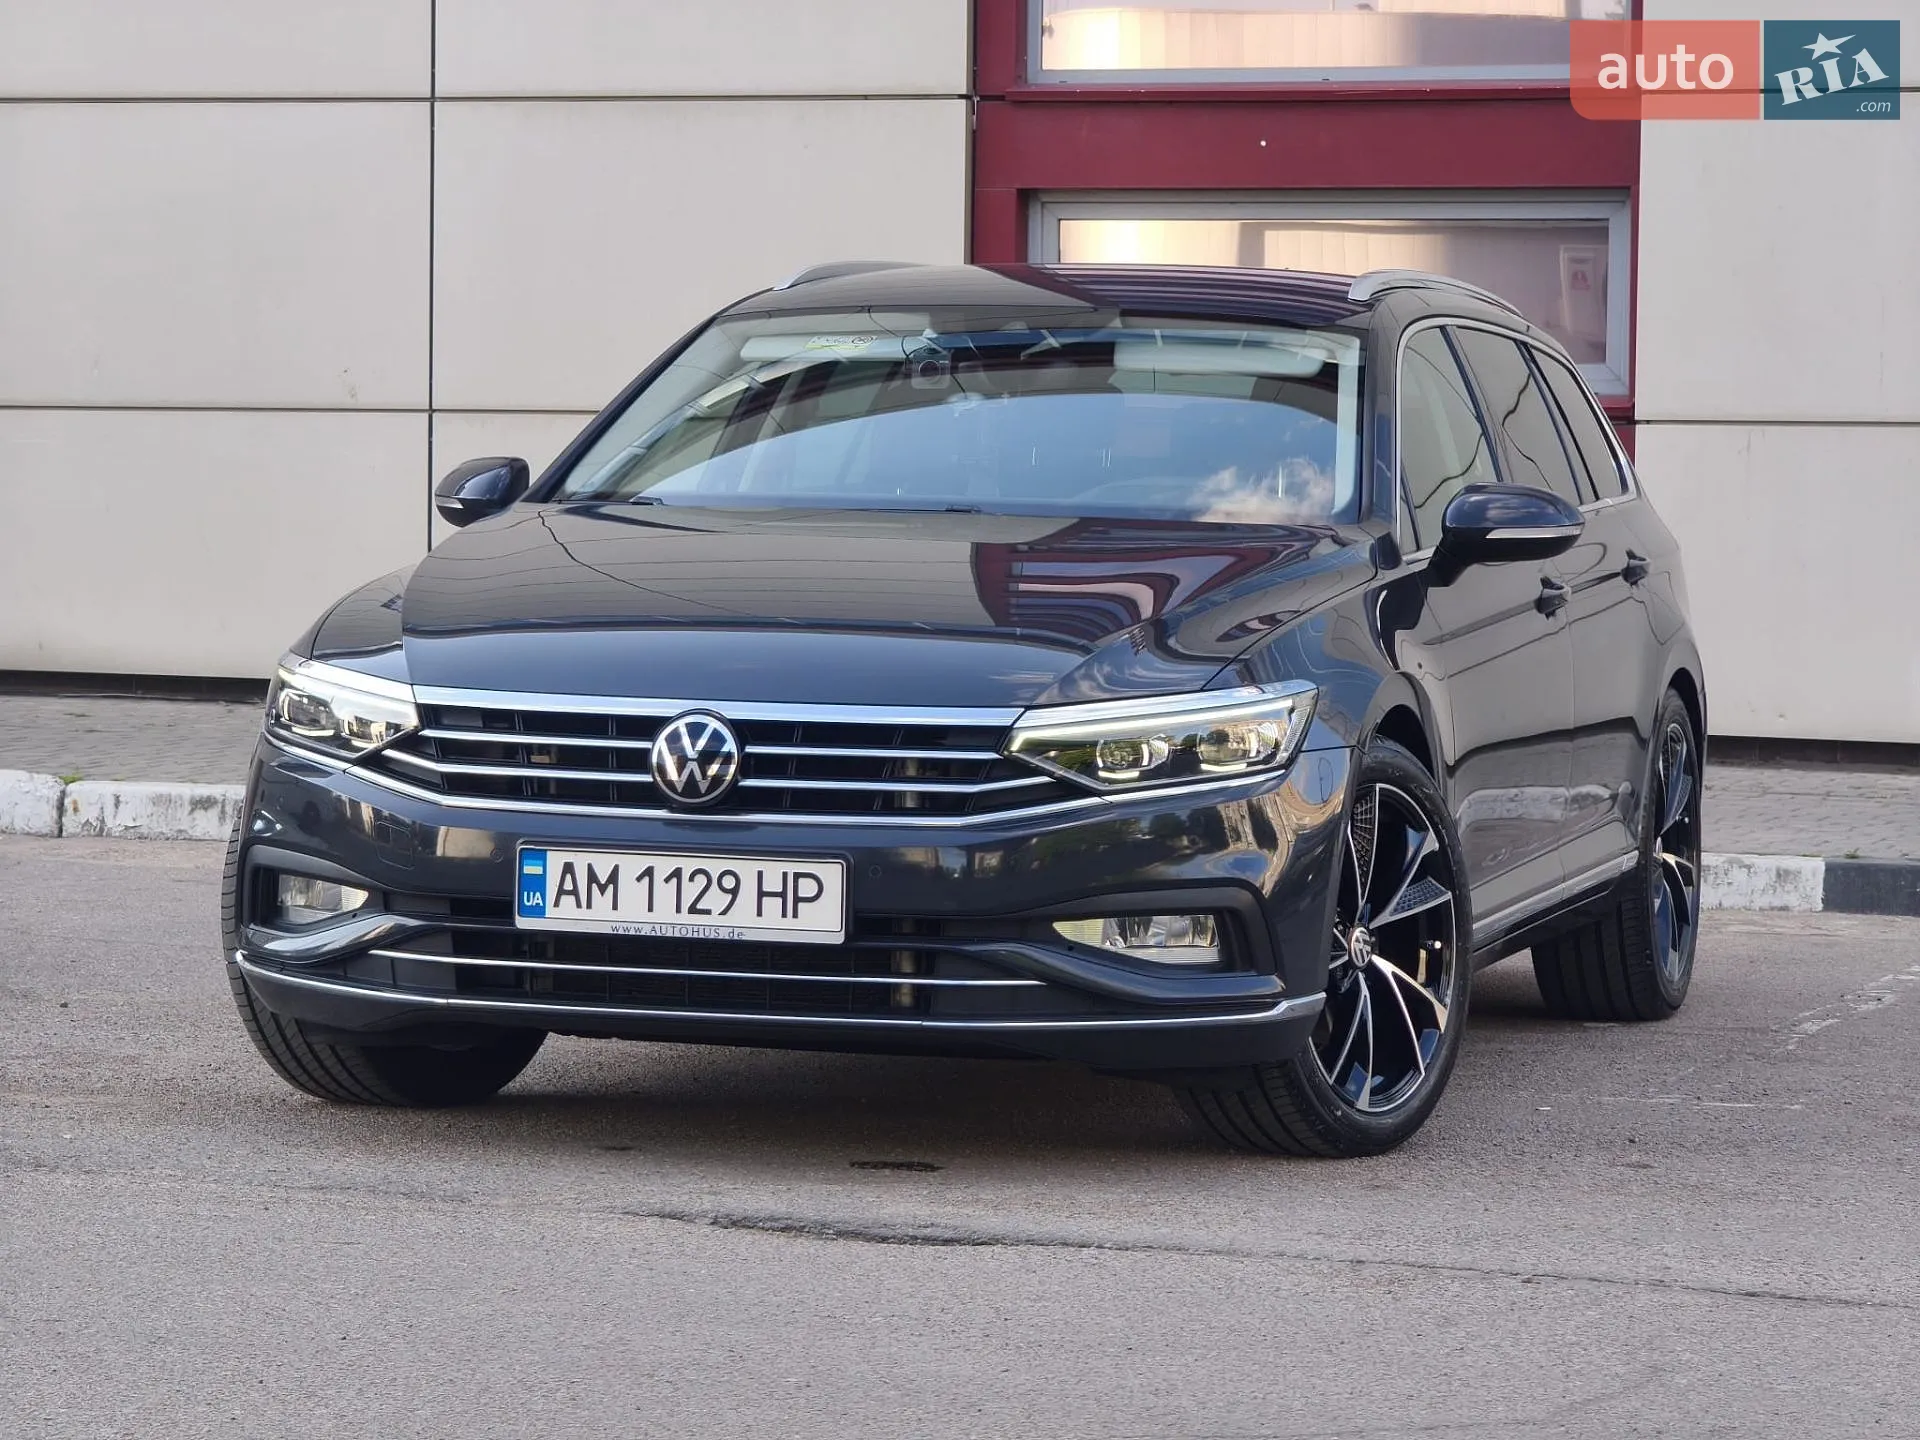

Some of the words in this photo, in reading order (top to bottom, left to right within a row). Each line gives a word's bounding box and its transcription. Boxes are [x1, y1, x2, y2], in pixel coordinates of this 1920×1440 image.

[553, 861, 620, 911] AM
[635, 865, 742, 916] 1129
[756, 869, 824, 919] HP
[523, 891, 543, 907] UA
[611, 924, 745, 939] www.AUTOHUS.de
